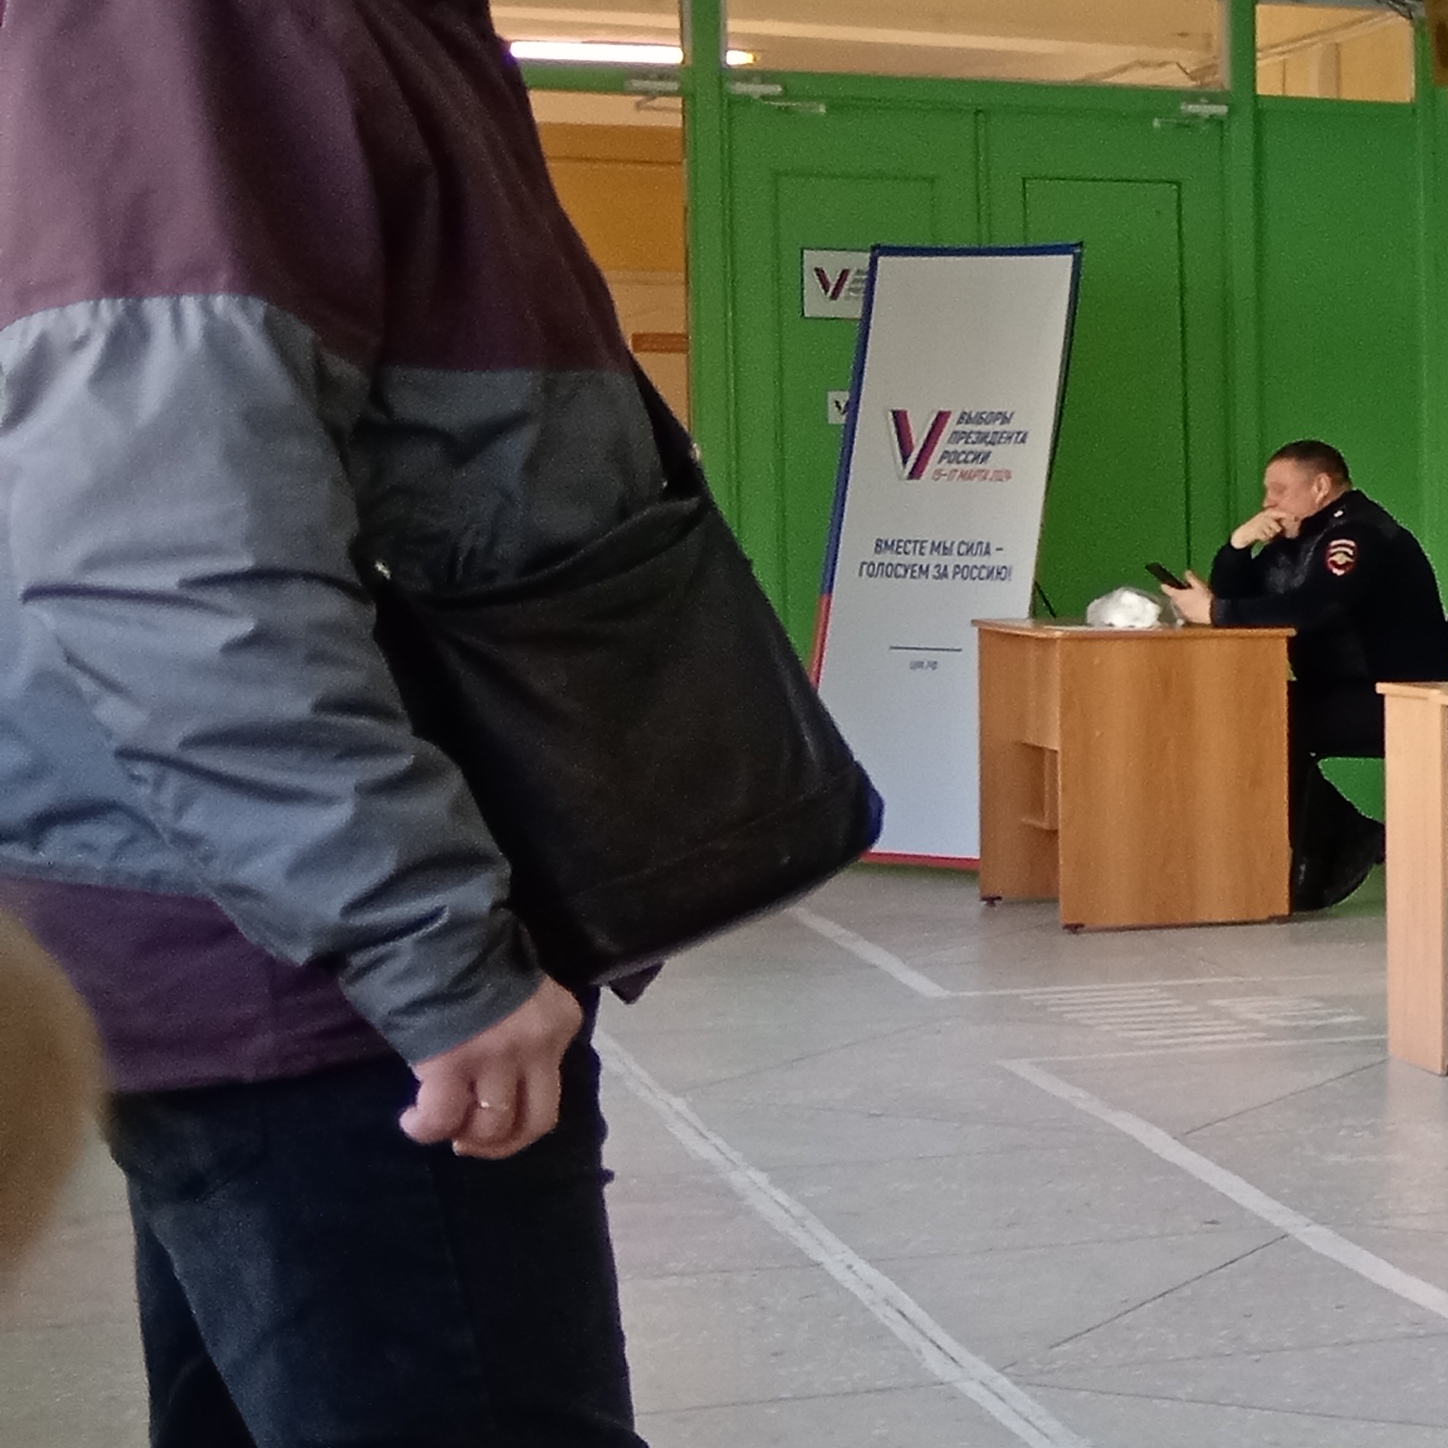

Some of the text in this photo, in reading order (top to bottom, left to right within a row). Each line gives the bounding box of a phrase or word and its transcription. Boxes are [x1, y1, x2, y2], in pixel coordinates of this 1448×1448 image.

[956, 411, 1014, 425] ВЫБОРЫ
[947, 430, 1029, 445] ПРЕЗИДЕНТА
[938, 450, 992, 464] РОССИИ
[874, 537, 928, 556] ВМЕСТЕ
[929, 540, 955, 556] МЫ
[956, 540, 991, 556] СИЛА
[858, 560, 1012, 581] ГОЛОСУЕМ ЗА РОССИЮ!
